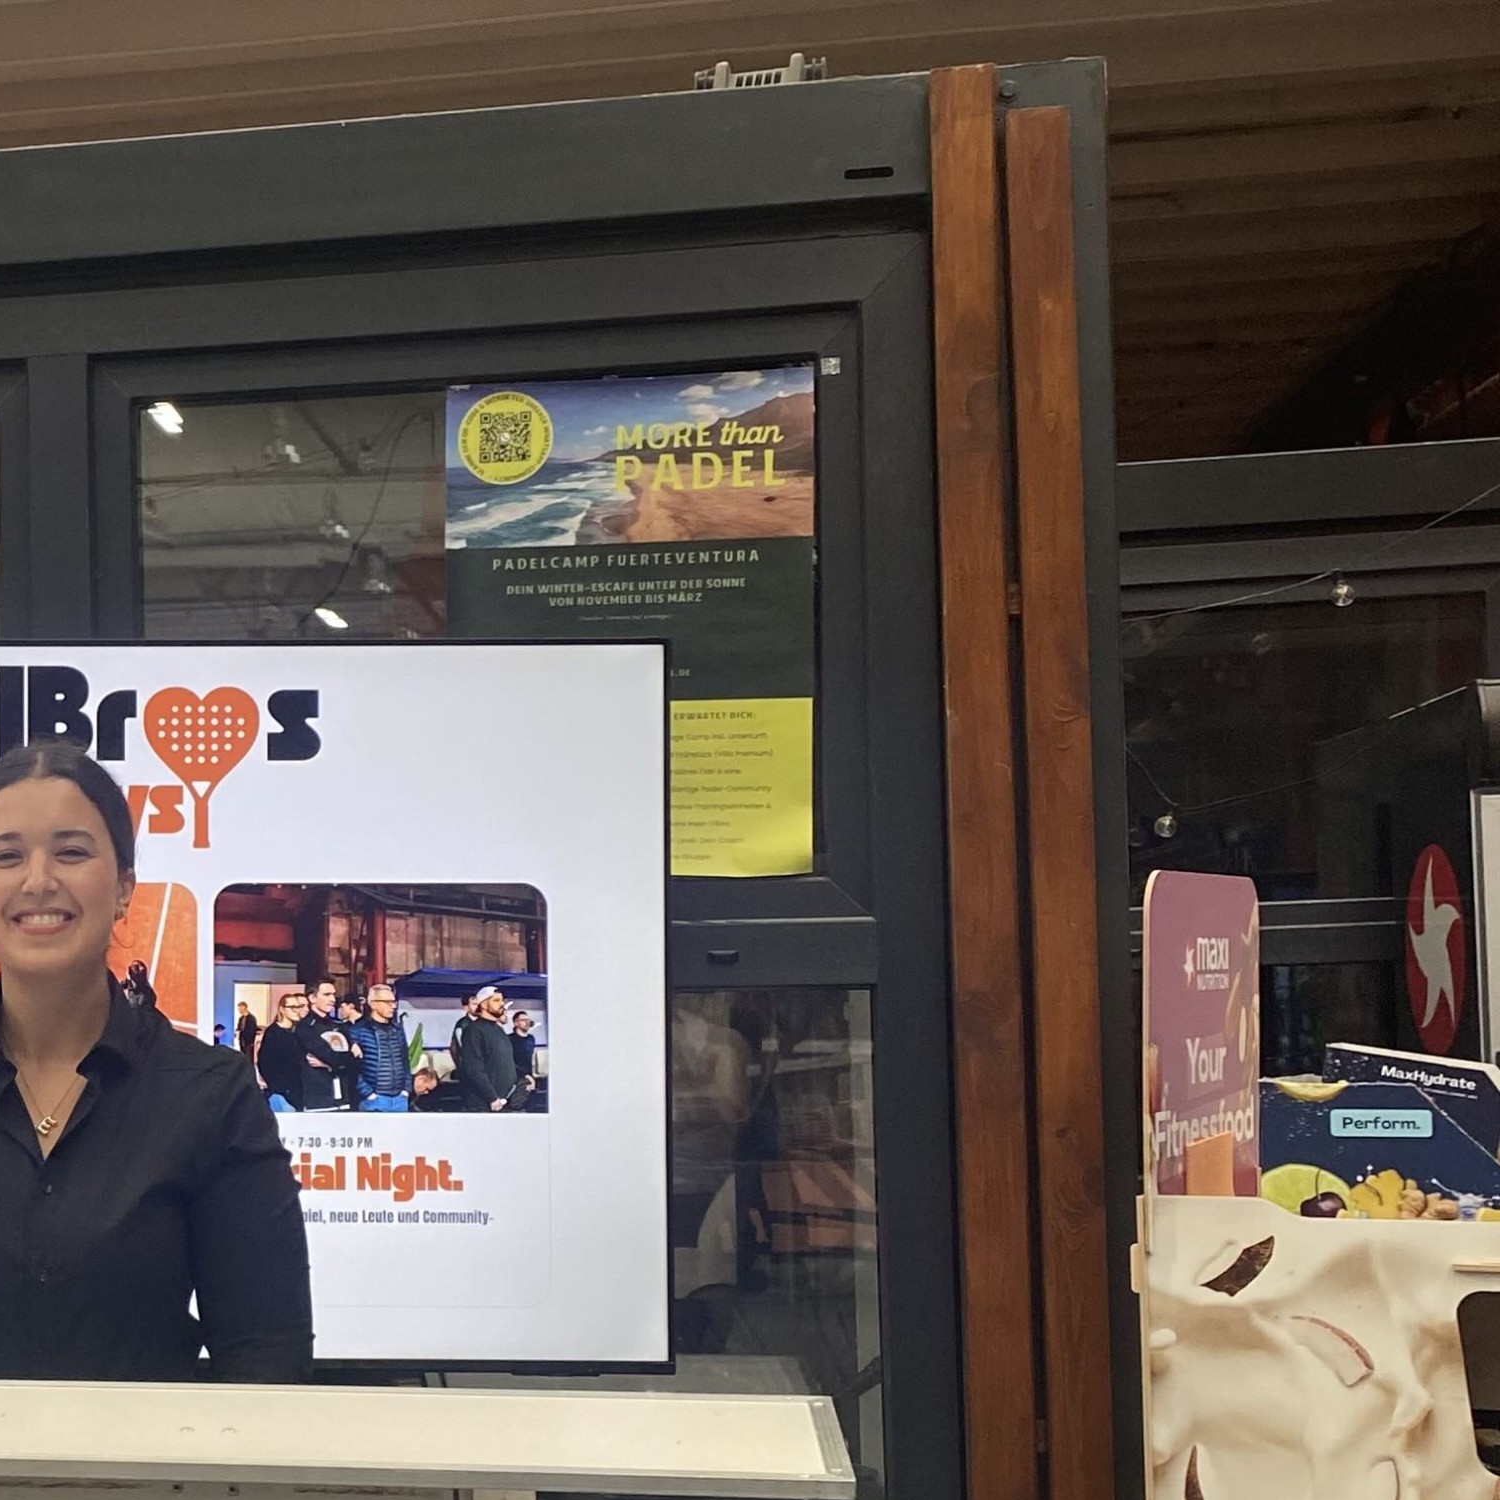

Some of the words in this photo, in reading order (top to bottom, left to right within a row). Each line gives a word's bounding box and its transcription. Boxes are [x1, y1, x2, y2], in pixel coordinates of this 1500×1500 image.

[615, 421, 713, 450] MORE
[719, 421, 784, 446] than
[615, 449, 786, 493] PADEL
[492, 555, 600, 571] PADELCAMP
[607, 549, 760, 567] FUERTEVENTURA
[506, 585, 534, 595] DEIN
[537, 582, 635, 594] WINTER-ESCAPE
[638, 580, 677, 591] UNTER
[680, 579, 703, 589] DER
[706, 578, 746, 588] SONNE
[548, 597, 574, 607] VON
[576, 595, 642, 606] NOVEMBER
[645, 593, 665, 603] BIS
[667, 591, 703, 602] MÄRZ
[1186, 1037, 1227, 1084] Your
[1380, 1064, 1478, 1091] MaxHydrate
[1342, 1116, 1421, 1130] Perform.
[298, 1136, 322, 1148] 7:30
[357, 1136, 374, 1148] PM
[291, 1152, 346, 1191] ial
[356, 1152, 464, 1202] Night.
[329, 1210, 359, 1223] neue
[362, 1208, 395, 1224] Leute
[397, 1208, 420, 1224] und
[422, 1208, 495, 1226] Community-
